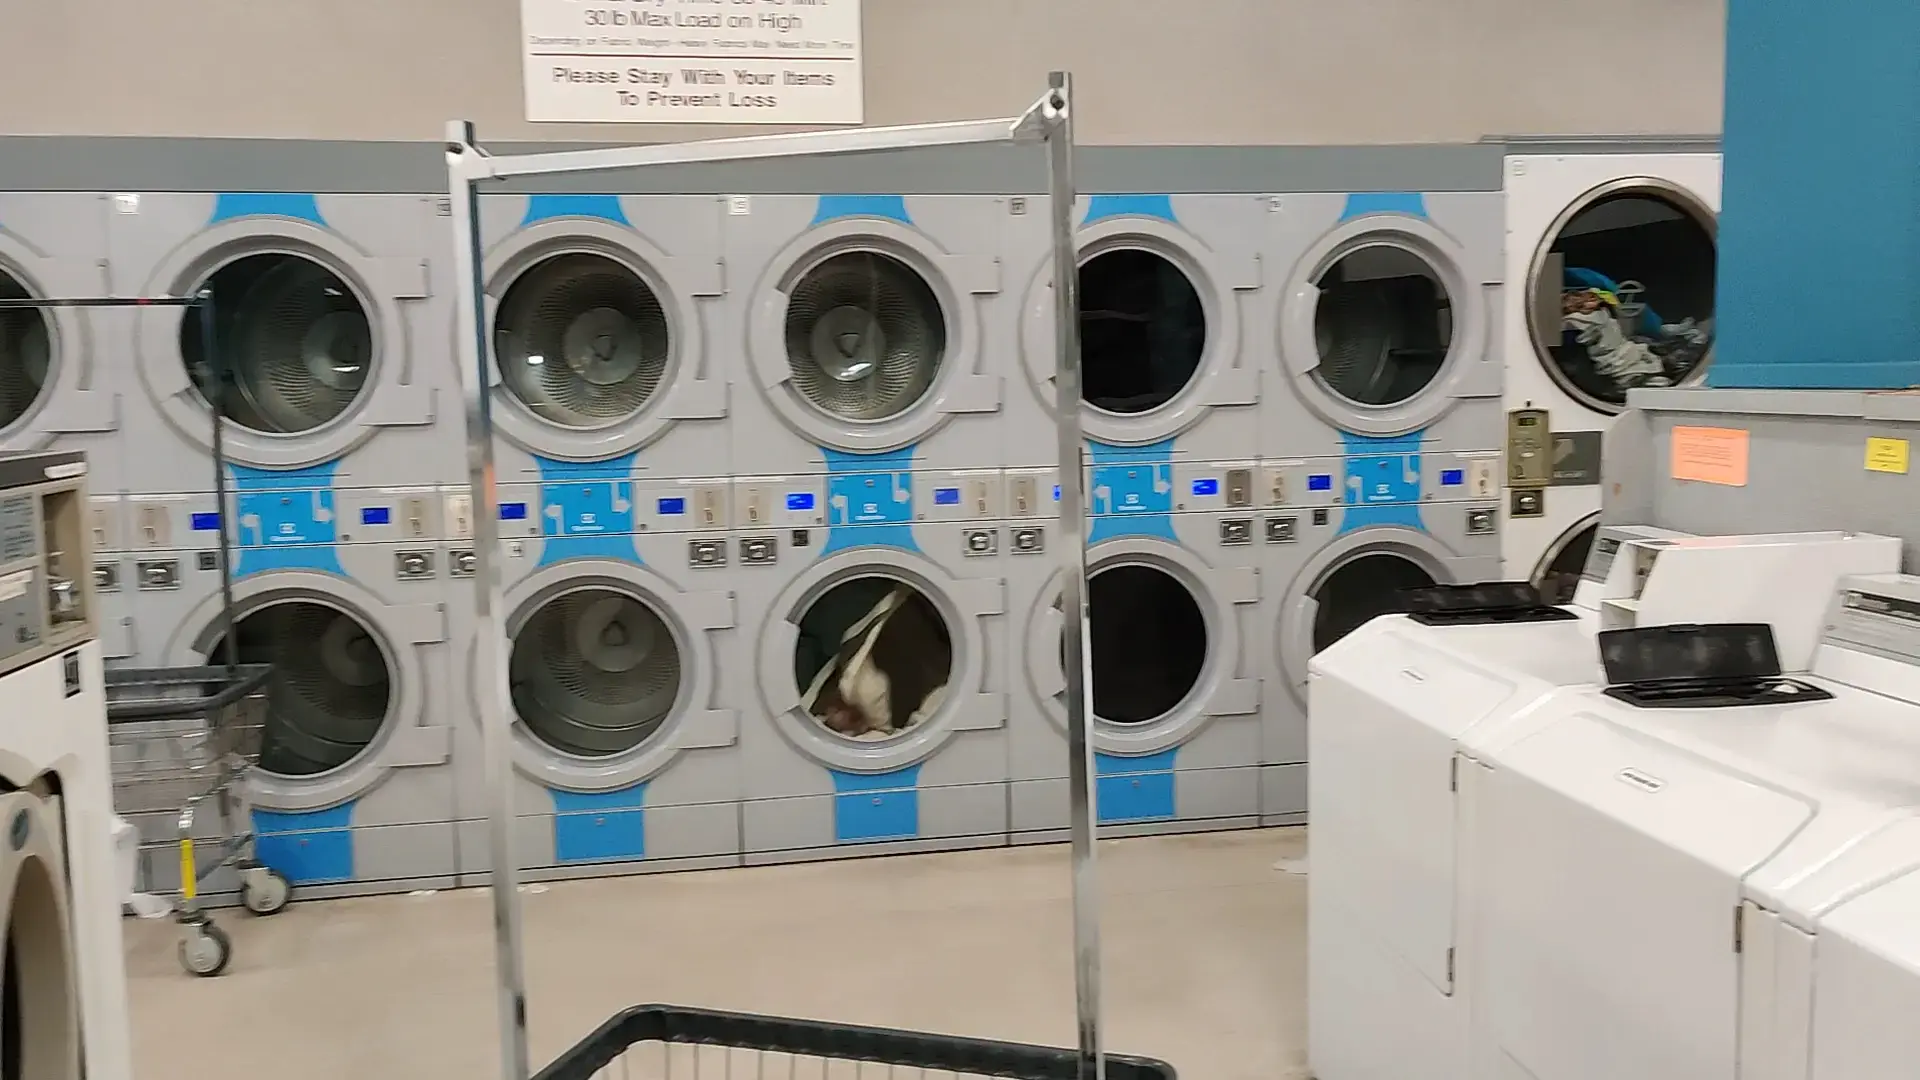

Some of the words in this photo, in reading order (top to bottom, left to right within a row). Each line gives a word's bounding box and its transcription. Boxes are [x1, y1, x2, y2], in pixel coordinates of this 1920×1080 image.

[585, 9, 607, 26] 30
[630, 10, 672, 27] Max
[675, 11, 722, 28] Load
[727, 16, 752, 28] on
[758, 13, 803, 33] High
[552, 66, 620, 83] Please
[627, 67, 673, 88] Stay
[680, 68, 726, 85] With
[733, 69, 776, 86] Your
[783, 70, 836, 86] Items
[616, 90, 640, 106] To
[647, 90, 722, 107] Prevent
[728, 91, 778, 108] Loss
